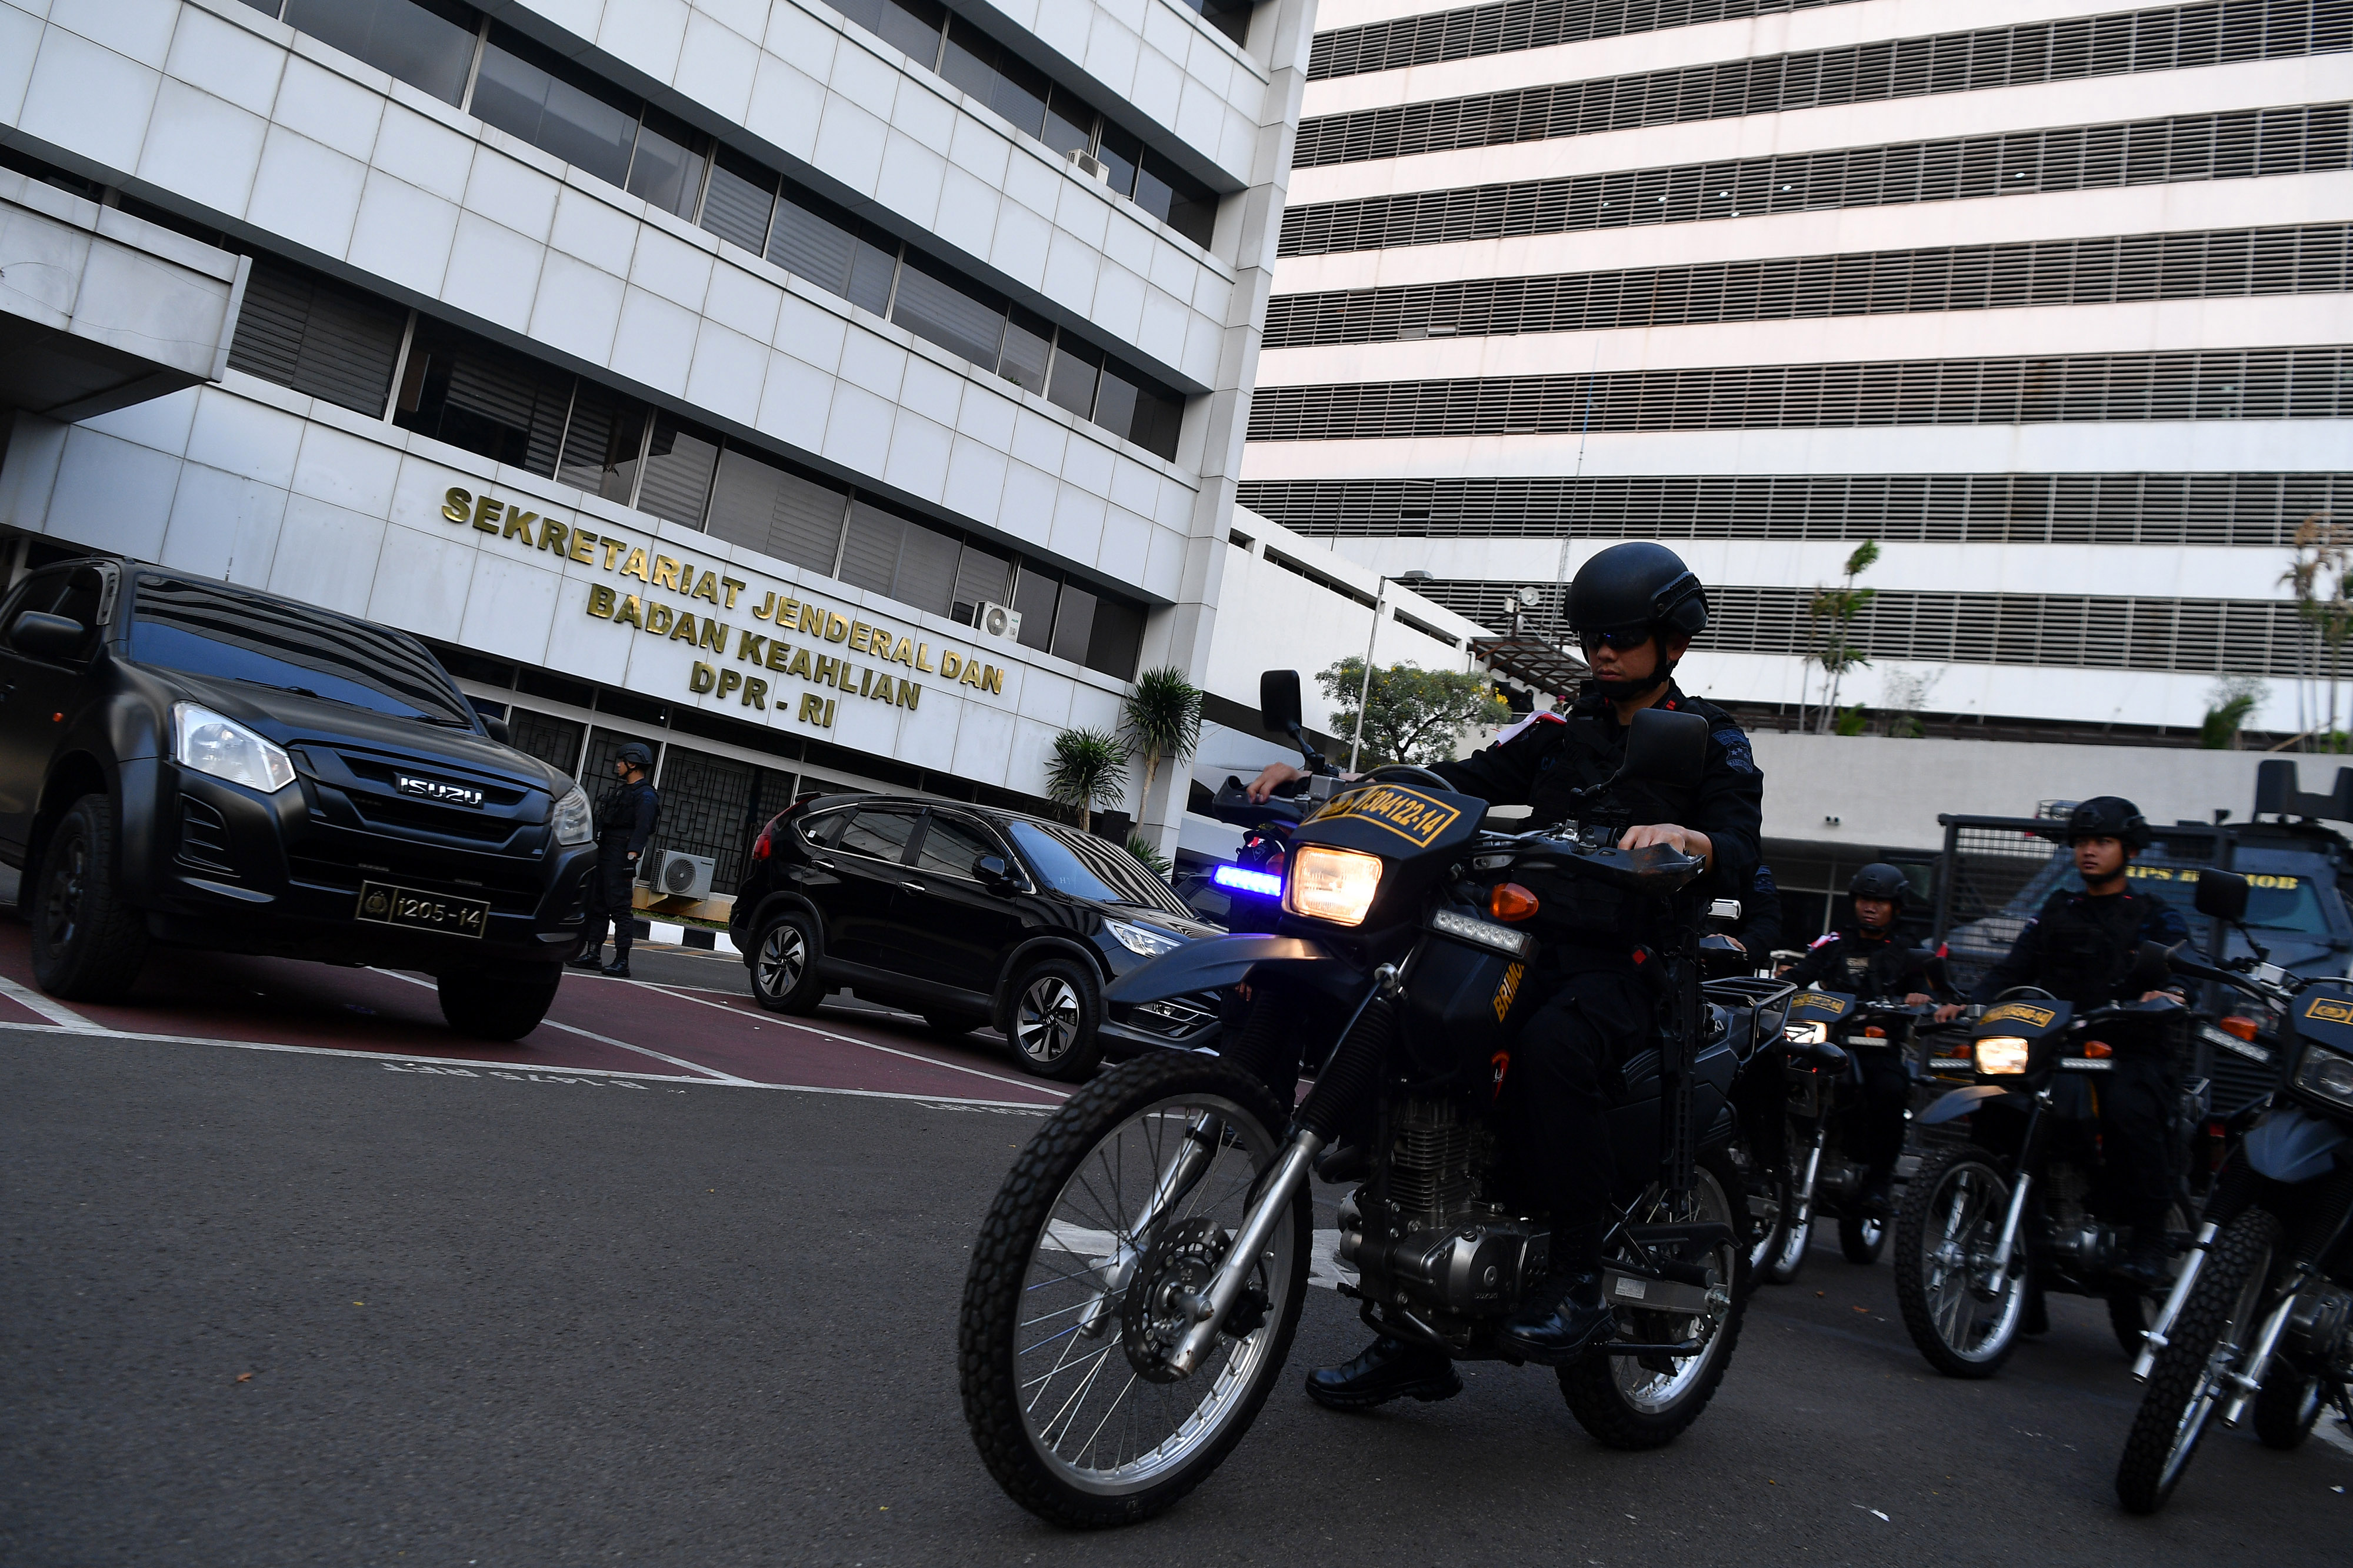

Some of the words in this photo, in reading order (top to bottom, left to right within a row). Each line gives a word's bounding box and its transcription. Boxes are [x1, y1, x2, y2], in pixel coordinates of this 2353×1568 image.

[441, 486, 745, 609] SEKRETARIAT
[753, 591, 934, 672] JENDERAL
[941, 649, 1005, 695] DAN
[586, 583, 729, 653] BADAN
[738, 630, 922, 710] KEAHLIAN
[689, 660, 768, 710] DPR
[798, 692, 835, 728] RI
[401, 777, 482, 805] ISUZU
